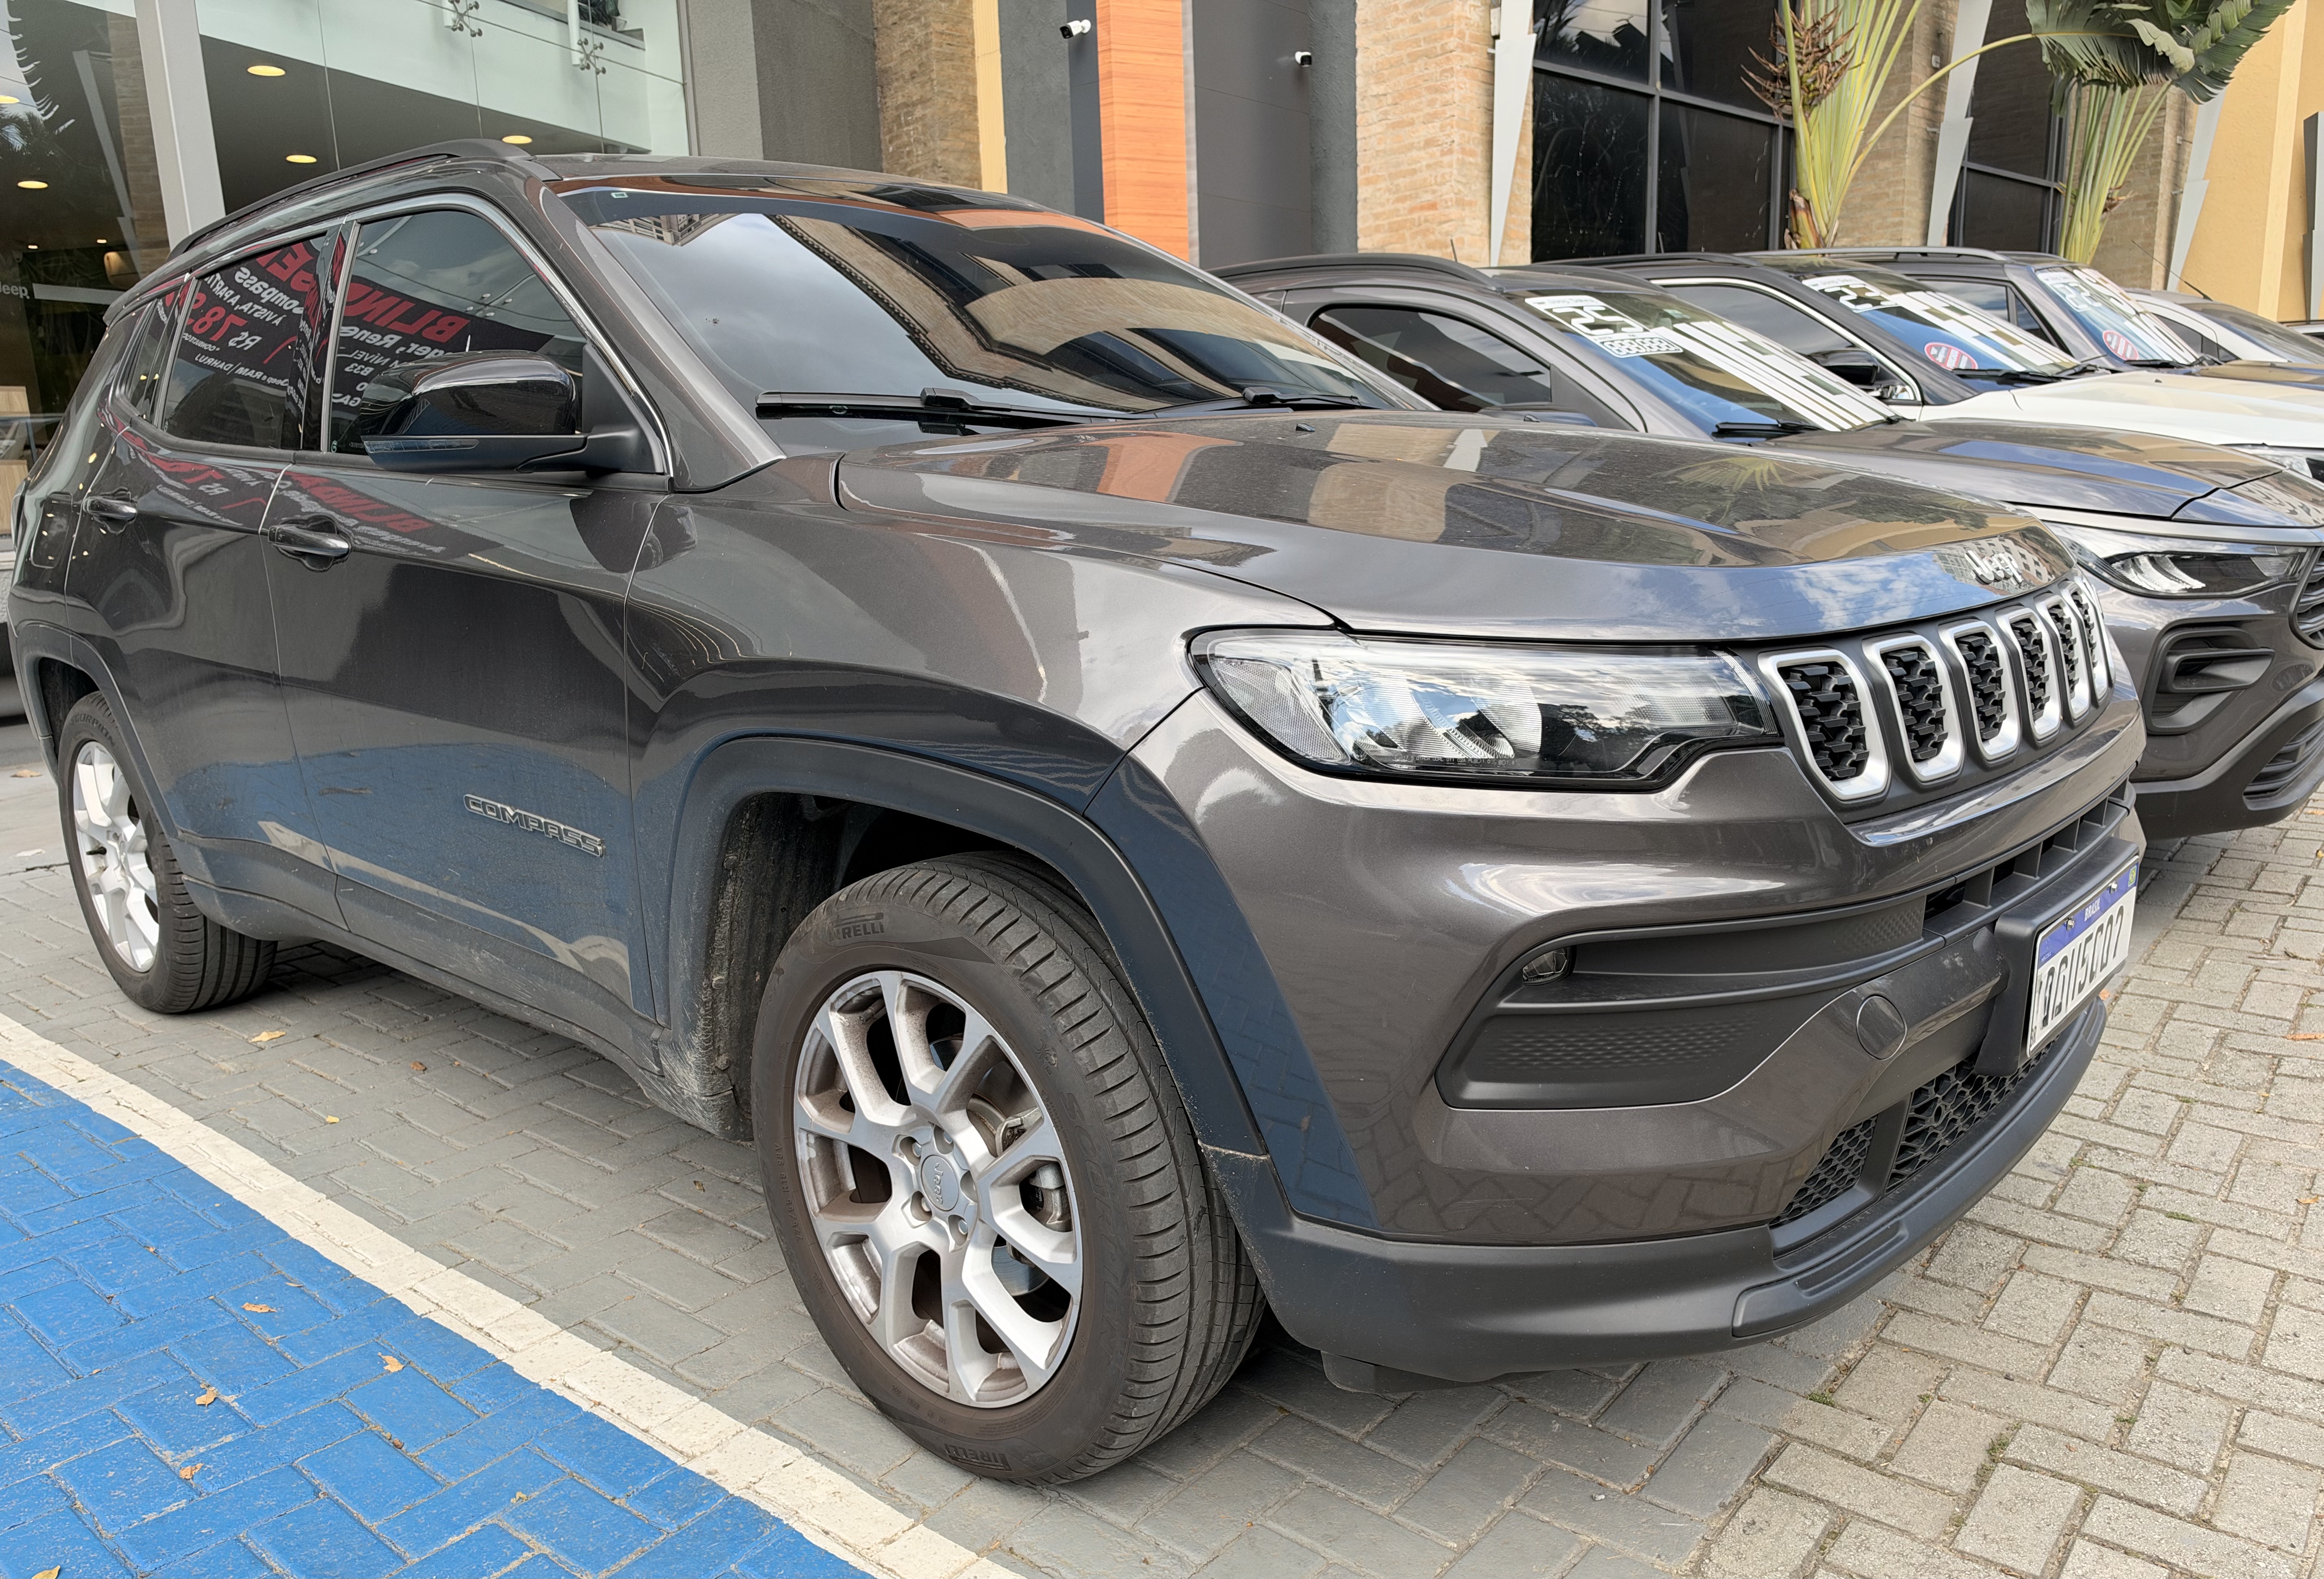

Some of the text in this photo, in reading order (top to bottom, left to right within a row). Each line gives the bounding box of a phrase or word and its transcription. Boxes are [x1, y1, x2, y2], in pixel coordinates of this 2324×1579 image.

[1553, 306, 1643, 335] 25
[1964, 550, 2023, 585] Jeep
[463, 793, 605, 858] COMPASS
[2084, 897, 2101, 922] BRASIL
[933, 1161, 945, 1205] Jeep
[1057, 1092, 1120, 1360] SCORPION
[944, 1443, 1014, 1472] PIRELLI
